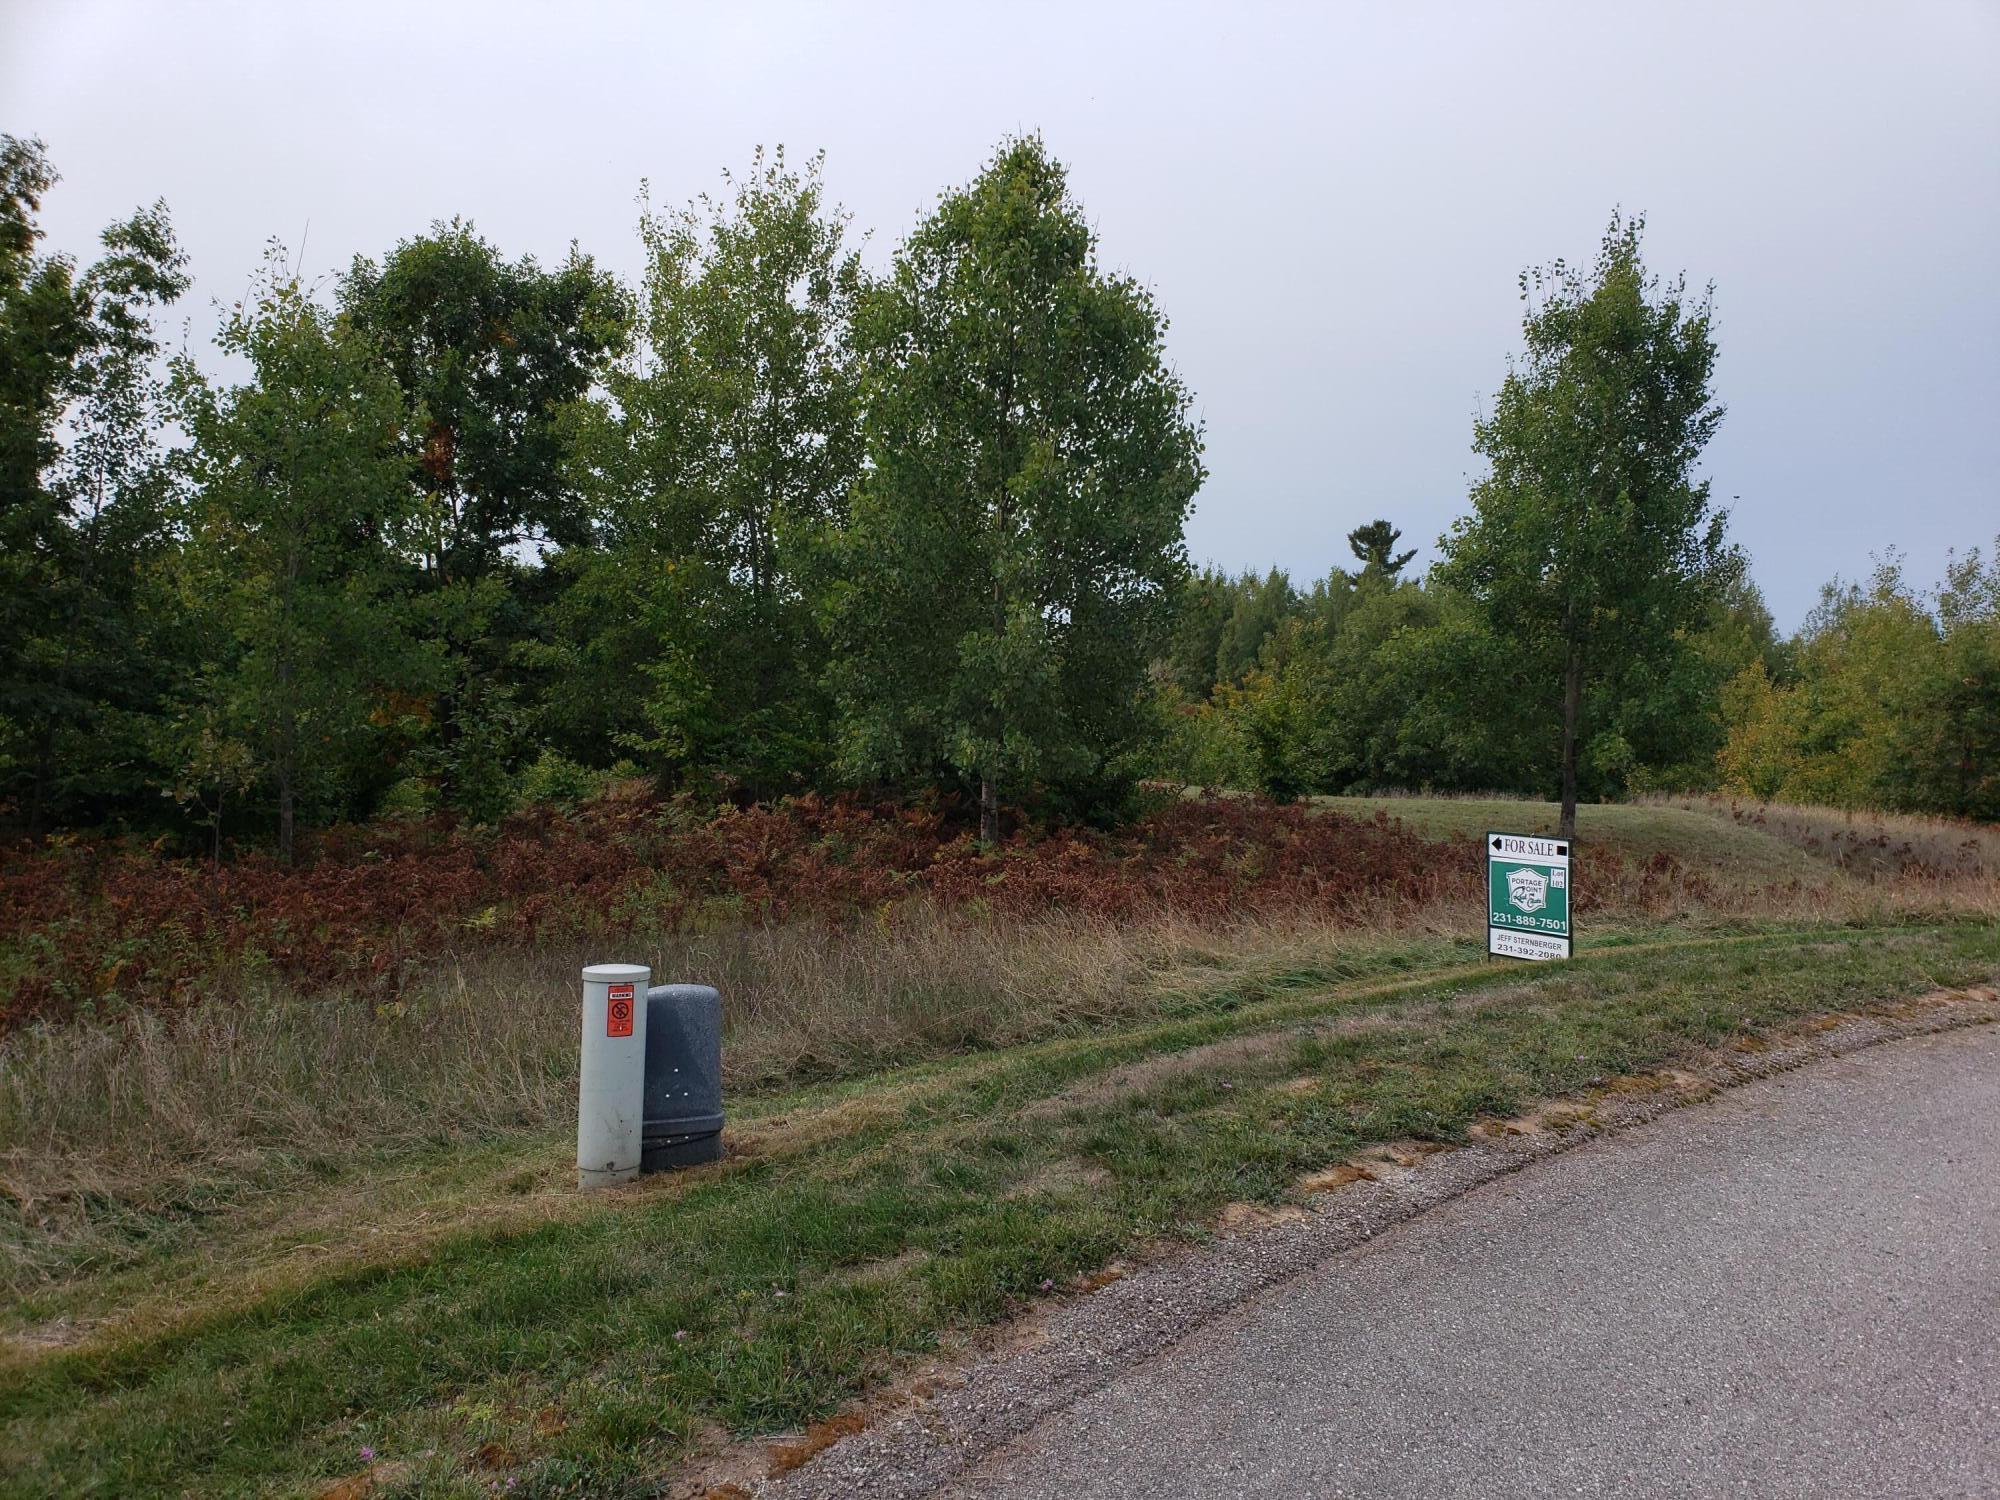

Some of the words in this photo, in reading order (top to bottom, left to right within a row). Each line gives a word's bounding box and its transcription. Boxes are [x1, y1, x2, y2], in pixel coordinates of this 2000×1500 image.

[1504, 838, 1526, 853] FOR
[1528, 841, 1554, 856] SALE
[1512, 878, 1543, 886] PORTAGE
[1492, 912, 1566, 930] 231-889-7501
[1497, 934, 1512, 942] JEFF
[1513, 936, 1563, 951] STERNBERGER
